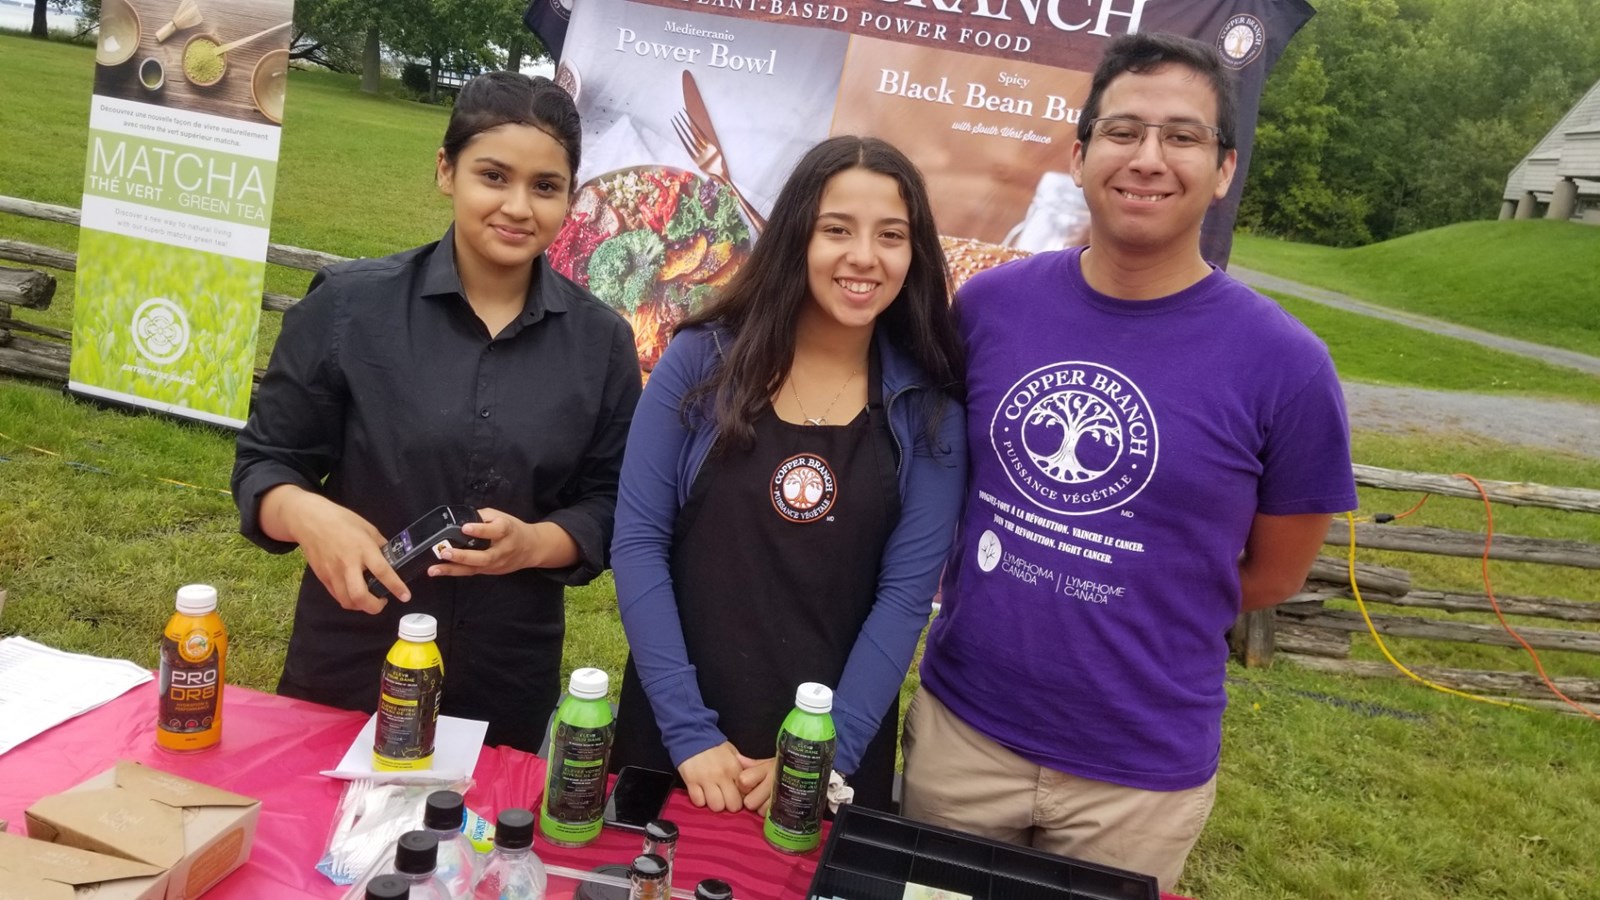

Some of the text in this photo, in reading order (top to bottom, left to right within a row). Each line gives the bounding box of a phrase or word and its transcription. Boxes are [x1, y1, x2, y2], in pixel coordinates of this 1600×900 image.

[664, 21, 735, 42] Mediterranio
[859, 11, 948, 41] POWER
[958, 28, 1032, 54] FOOD
[1221, 17, 1262, 45] COPPER BRANCH
[615, 27, 777, 75] Power Bowl
[998, 71, 1031, 89] Spicy
[876, 68, 1081, 125] Black Bean Bu
[139, 123, 156, 131] notre
[147, 113, 172, 123] nouvelle
[193, 121, 202, 129] de
[204, 122, 220, 132] vivre
[221, 127, 268, 140] naturellement
[952, 121, 1052, 145] with South West Sauce
[92, 136, 267, 205] MATCHA
[90, 174, 266, 222] THÉ VERT GREEN TEA
[115, 207, 143, 220] Discover
[178, 220, 187, 228] to
[188, 223, 210, 233] natural
[213, 227, 232, 239] living
[117, 220, 131, 228] with
[166, 230, 192, 241] matcha
[1005, 369, 1149, 457] COPPER BRANCH
[775, 457, 833, 492] COPPER BRANCH
[1003, 440, 1133, 504] PUISSANCE VÉGÉTALE
[774, 490, 800, 519] PUISSANCE
[1120, 509, 1135, 519] MD
[993, 513, 1113, 564] JOIN THE REVOLUTION. FIGHT CANCER.
[1016, 508, 1025, 520] LA
[1025, 512, 1070, 535] RÉVOLUTION.
[1072, 527, 1103, 544] VAINCRE
[1104, 535, 1114, 547] LE
[1115, 538, 1145, 553] CANCER.
[1001, 561, 1037, 586] CANADA
[1002, 551, 1054, 581] LYMPHOMA
[1064, 586, 1108, 605] CANADA
[1065, 575, 1127, 597] LYMPHOME
[171, 669, 217, 685] PRO
[170, 685, 216, 702] DR8
